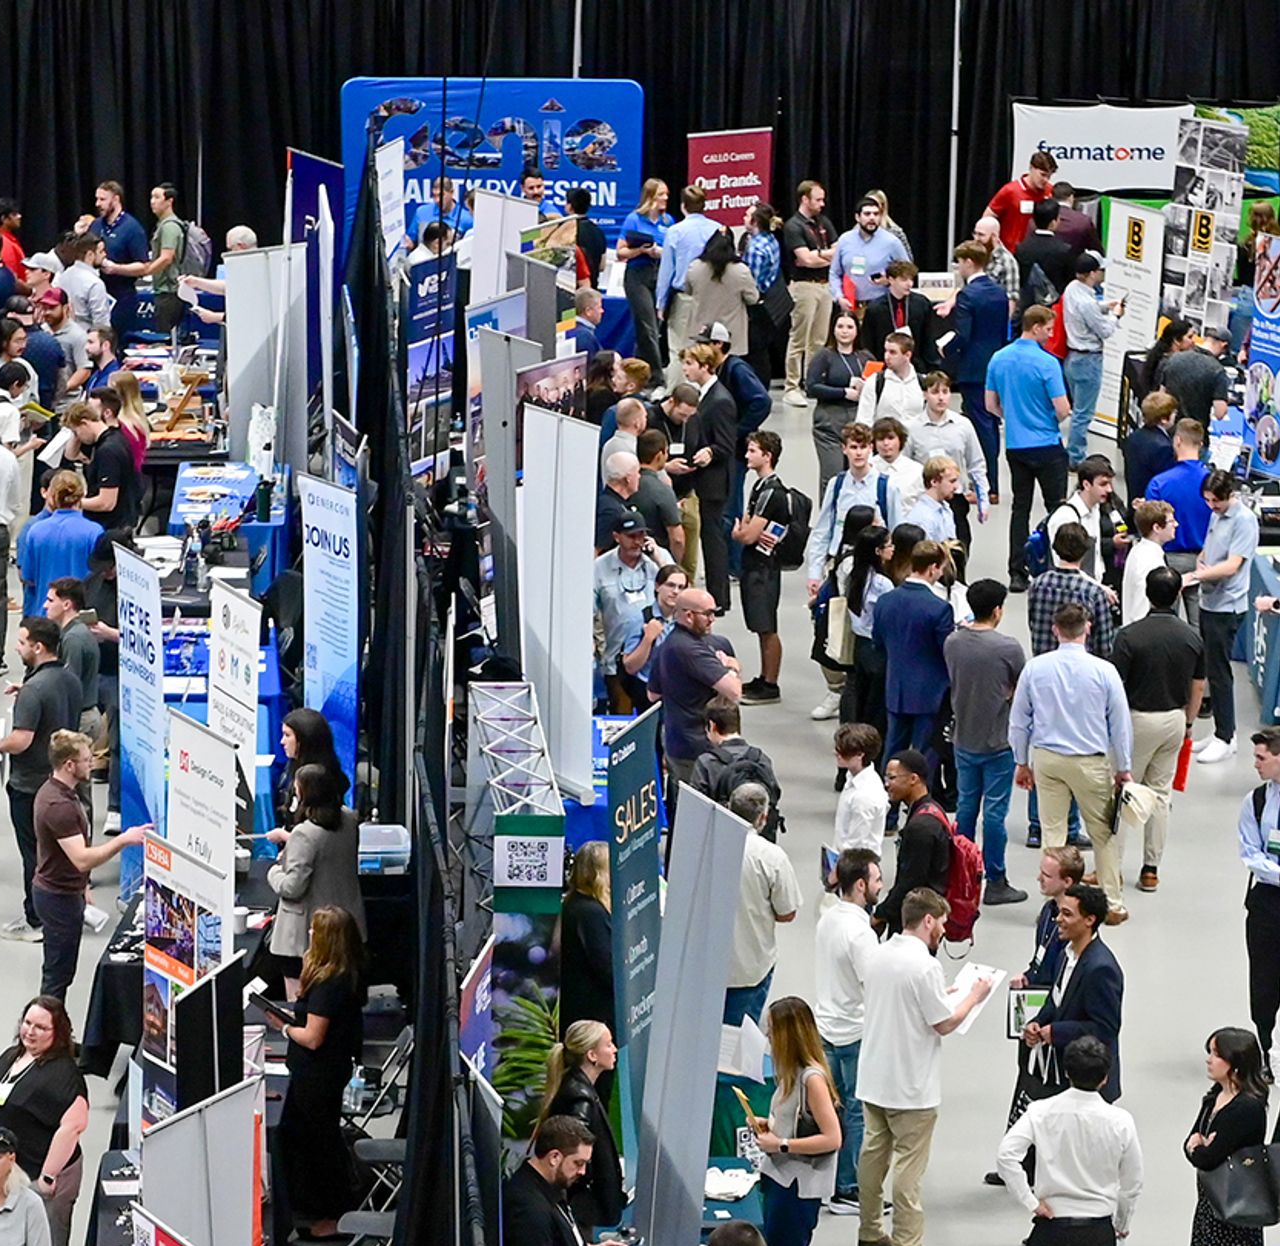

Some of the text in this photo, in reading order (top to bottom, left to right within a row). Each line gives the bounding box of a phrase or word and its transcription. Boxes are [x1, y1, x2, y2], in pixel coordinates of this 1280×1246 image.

[365, 97, 618, 171] Genie
[703, 152, 729, 164] GALLO
[1036, 140, 1165, 161] framatome
[482, 179, 518, 197] BY
[695, 172, 762, 190] Our Brands.
[317, 494, 350, 516] ENERCON
[305, 523, 350, 558] JOIN US
[122, 570, 150, 591] ENERCON
[119, 600, 151, 636] WE'RE
[119, 626, 156, 665] HIRING
[190, 759, 224, 788] Design Group
[614, 779, 658, 844] SALES
[194, 836, 213, 864] fully
